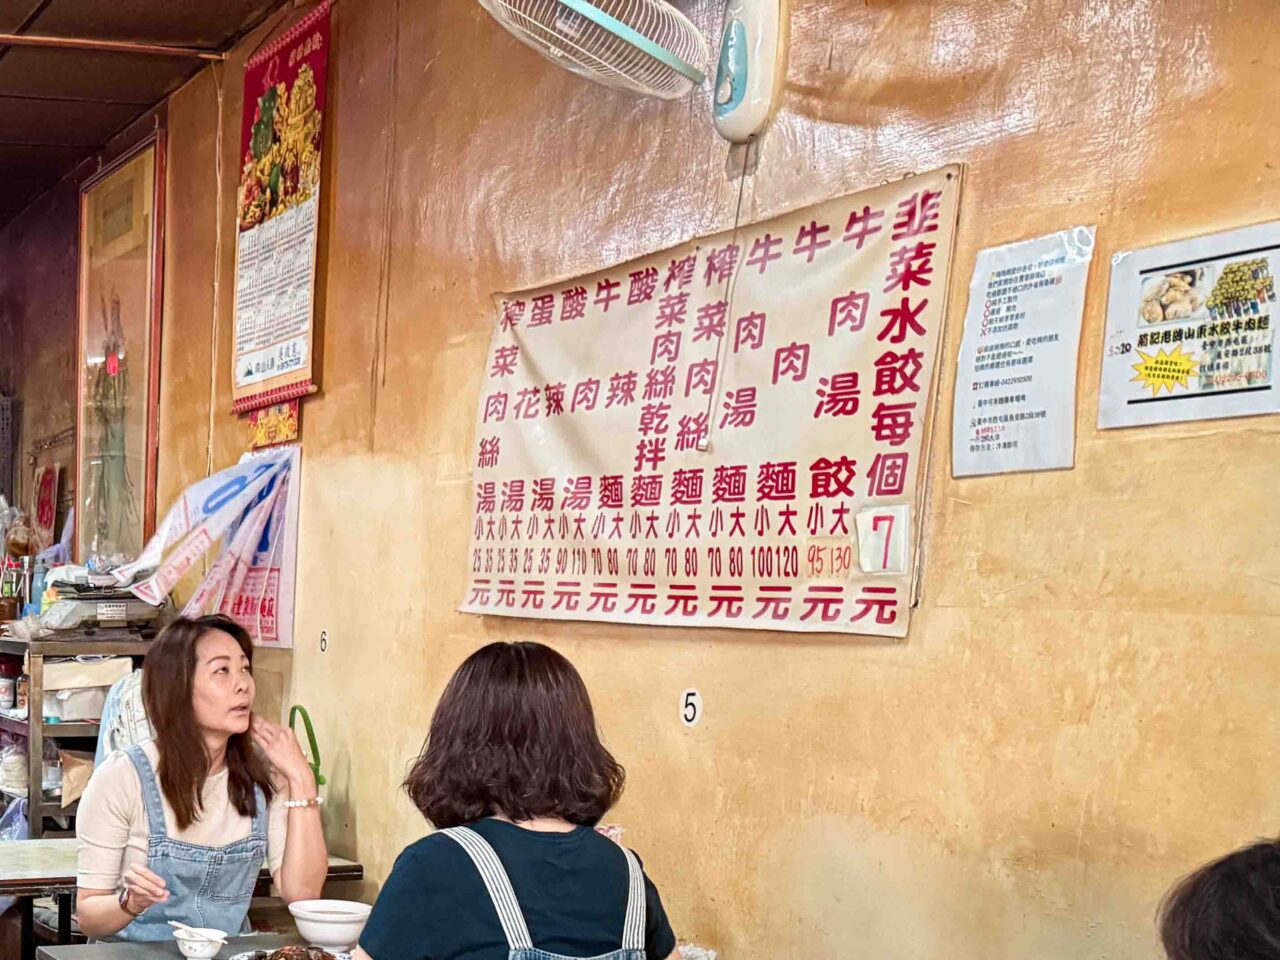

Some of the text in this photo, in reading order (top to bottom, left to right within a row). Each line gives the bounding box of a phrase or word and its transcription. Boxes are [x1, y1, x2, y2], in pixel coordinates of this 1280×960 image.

[850, 189, 942, 624] 韭菜水餃每個 7 元
[555, 547, 568, 574] 90
[571, 547, 587, 575] 110
[591, 547, 602, 576] 70
[607, 547, 618, 576] 80
[626, 547, 638, 576] 70
[644, 547, 656, 576] 80
[665, 547, 677, 577] 70
[685, 547, 698, 577] 80
[707, 547, 721, 577] 70
[729, 546, 743, 577] 80
[750, 546, 773, 578] 100
[775, 546, 798, 578] 120
[807, 545, 827, 575] 95
[830, 545, 851, 575] 130
[468, 579, 491, 606] 元
[495, 580, 516, 607] 元
[521, 581, 545, 609] 元
[551, 581, 581, 610] 元
[586, 583, 618, 612] 元
[624, 583, 657, 614] 元
[664, 584, 698, 616] 元
[707, 585, 744, 617] 元
[752, 586, 792, 619] 元
[799, 586, 844, 621] 元
[320, 632, 328, 652] 6
[684, 692, 697, 723] 5
